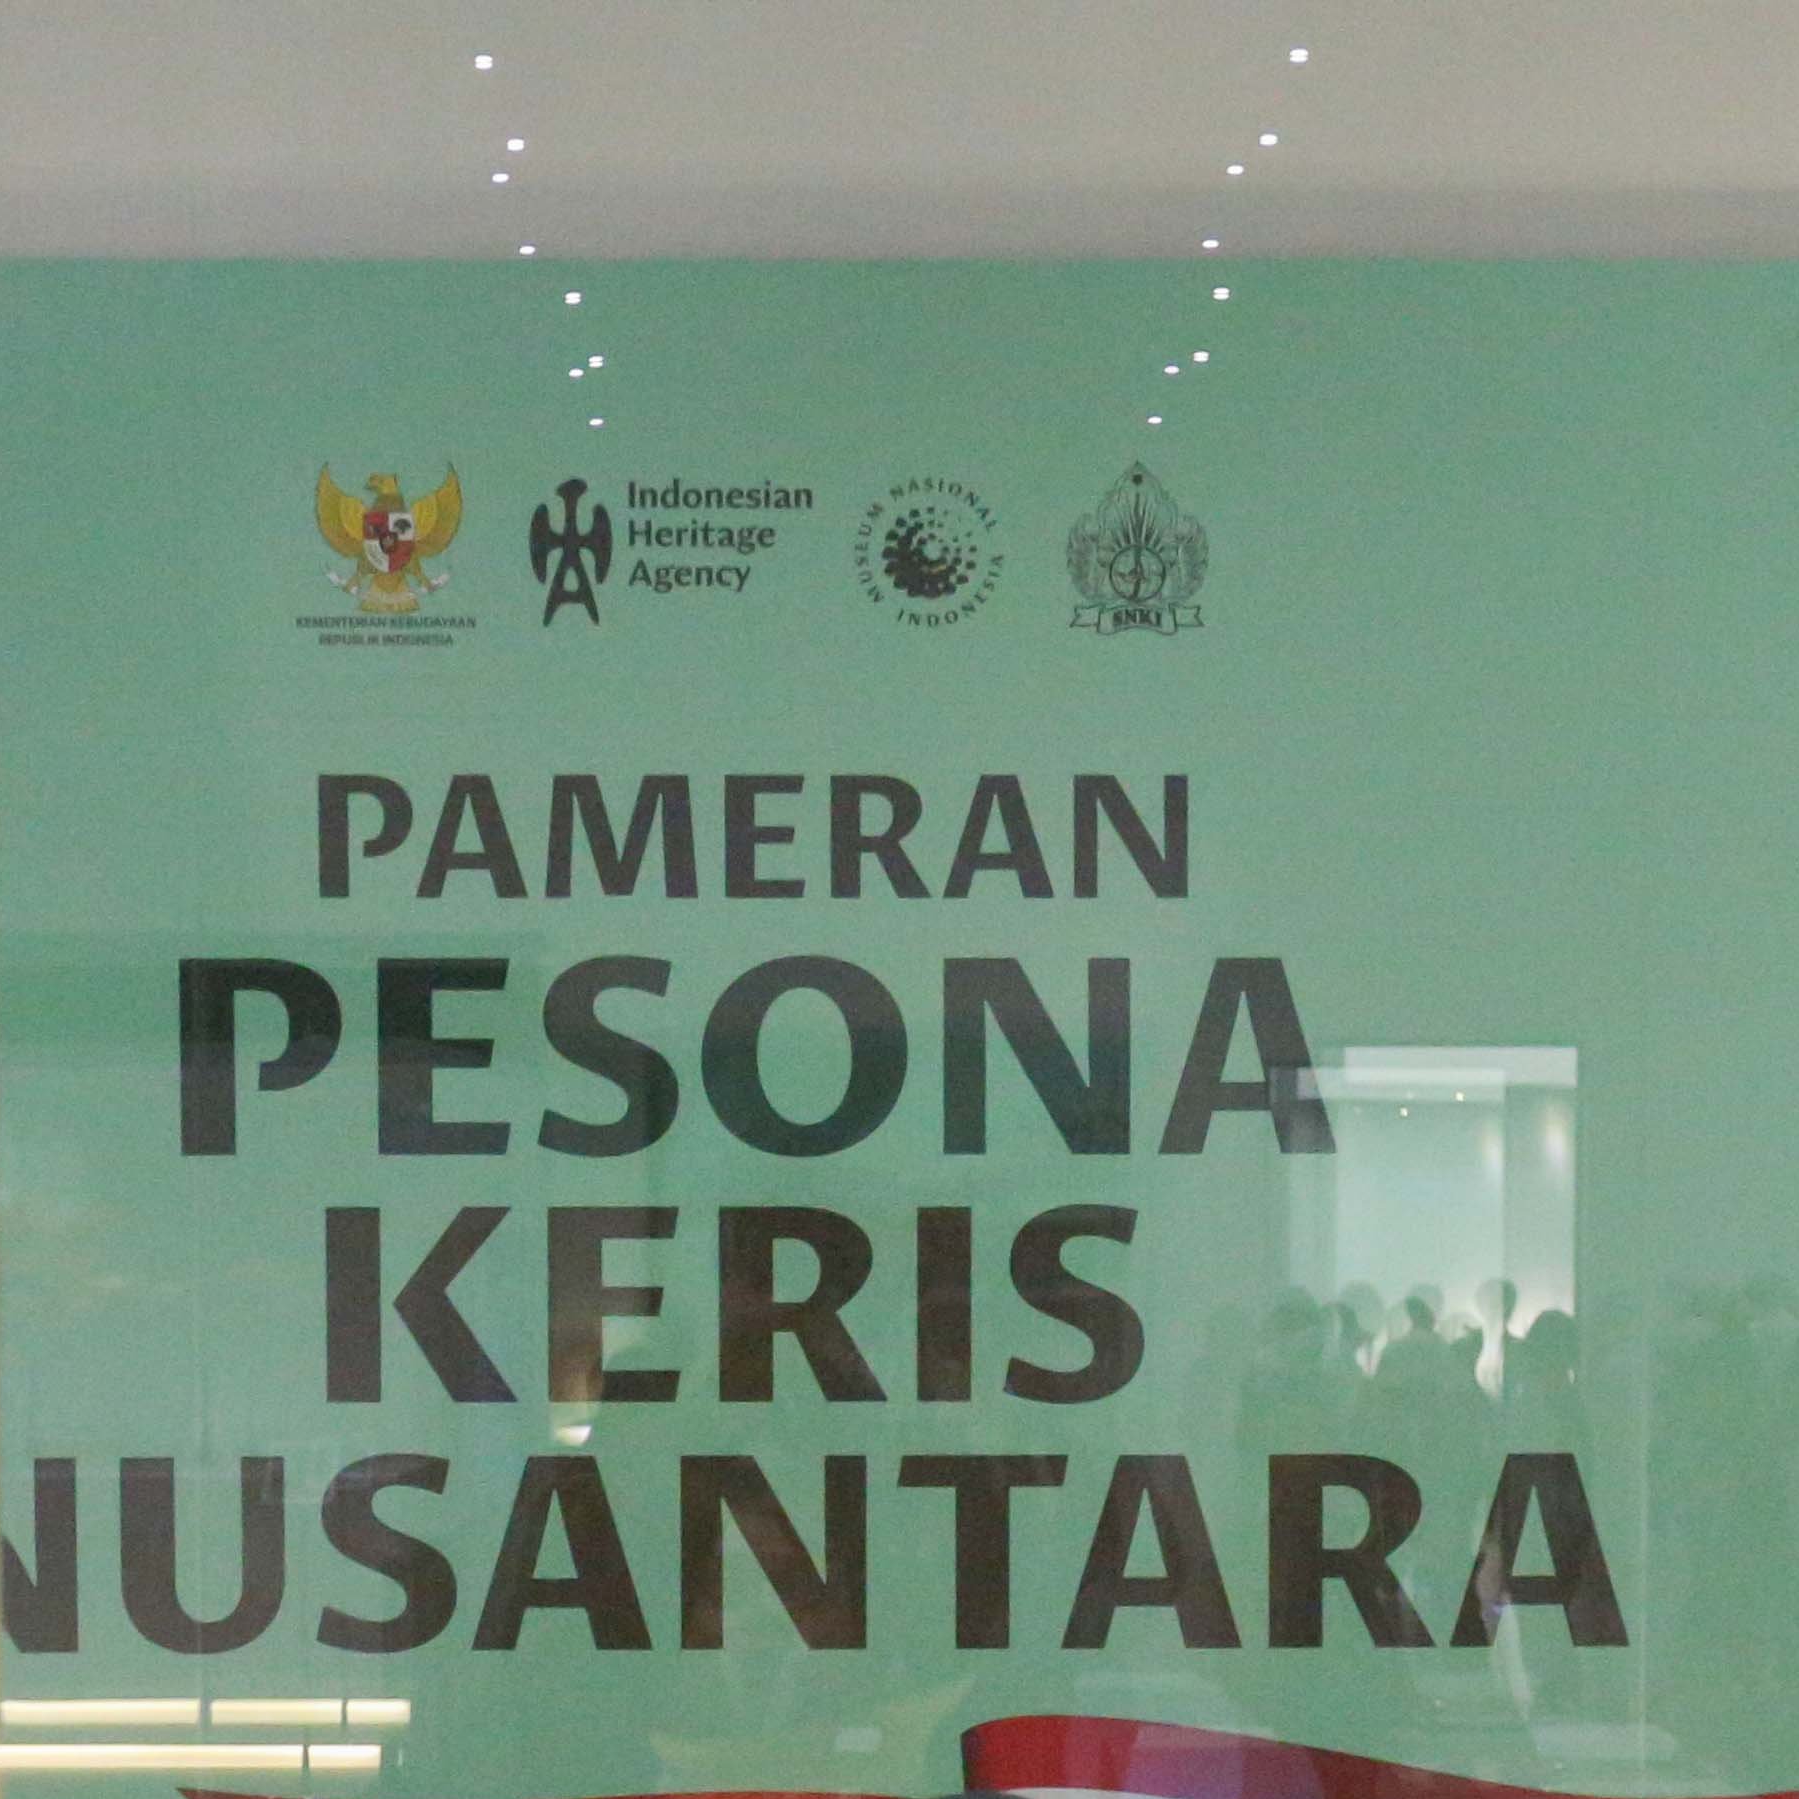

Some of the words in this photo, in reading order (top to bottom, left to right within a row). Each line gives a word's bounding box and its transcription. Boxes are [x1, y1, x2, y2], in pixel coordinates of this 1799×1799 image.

[628, 478, 813, 509] Indonesian
[889, 477, 997, 532] NASIONAL
[628, 519, 776, 555] Heritage
[854, 502, 884, 602] MUSEUM
[628, 559, 751, 594] Agency
[897, 554, 1004, 627] INDONESIA
[318, 774, 1189, 898] PAMERAN
[178, 955, 1337, 1158] PESONA
[325, 1203, 1145, 1405] KERIS
